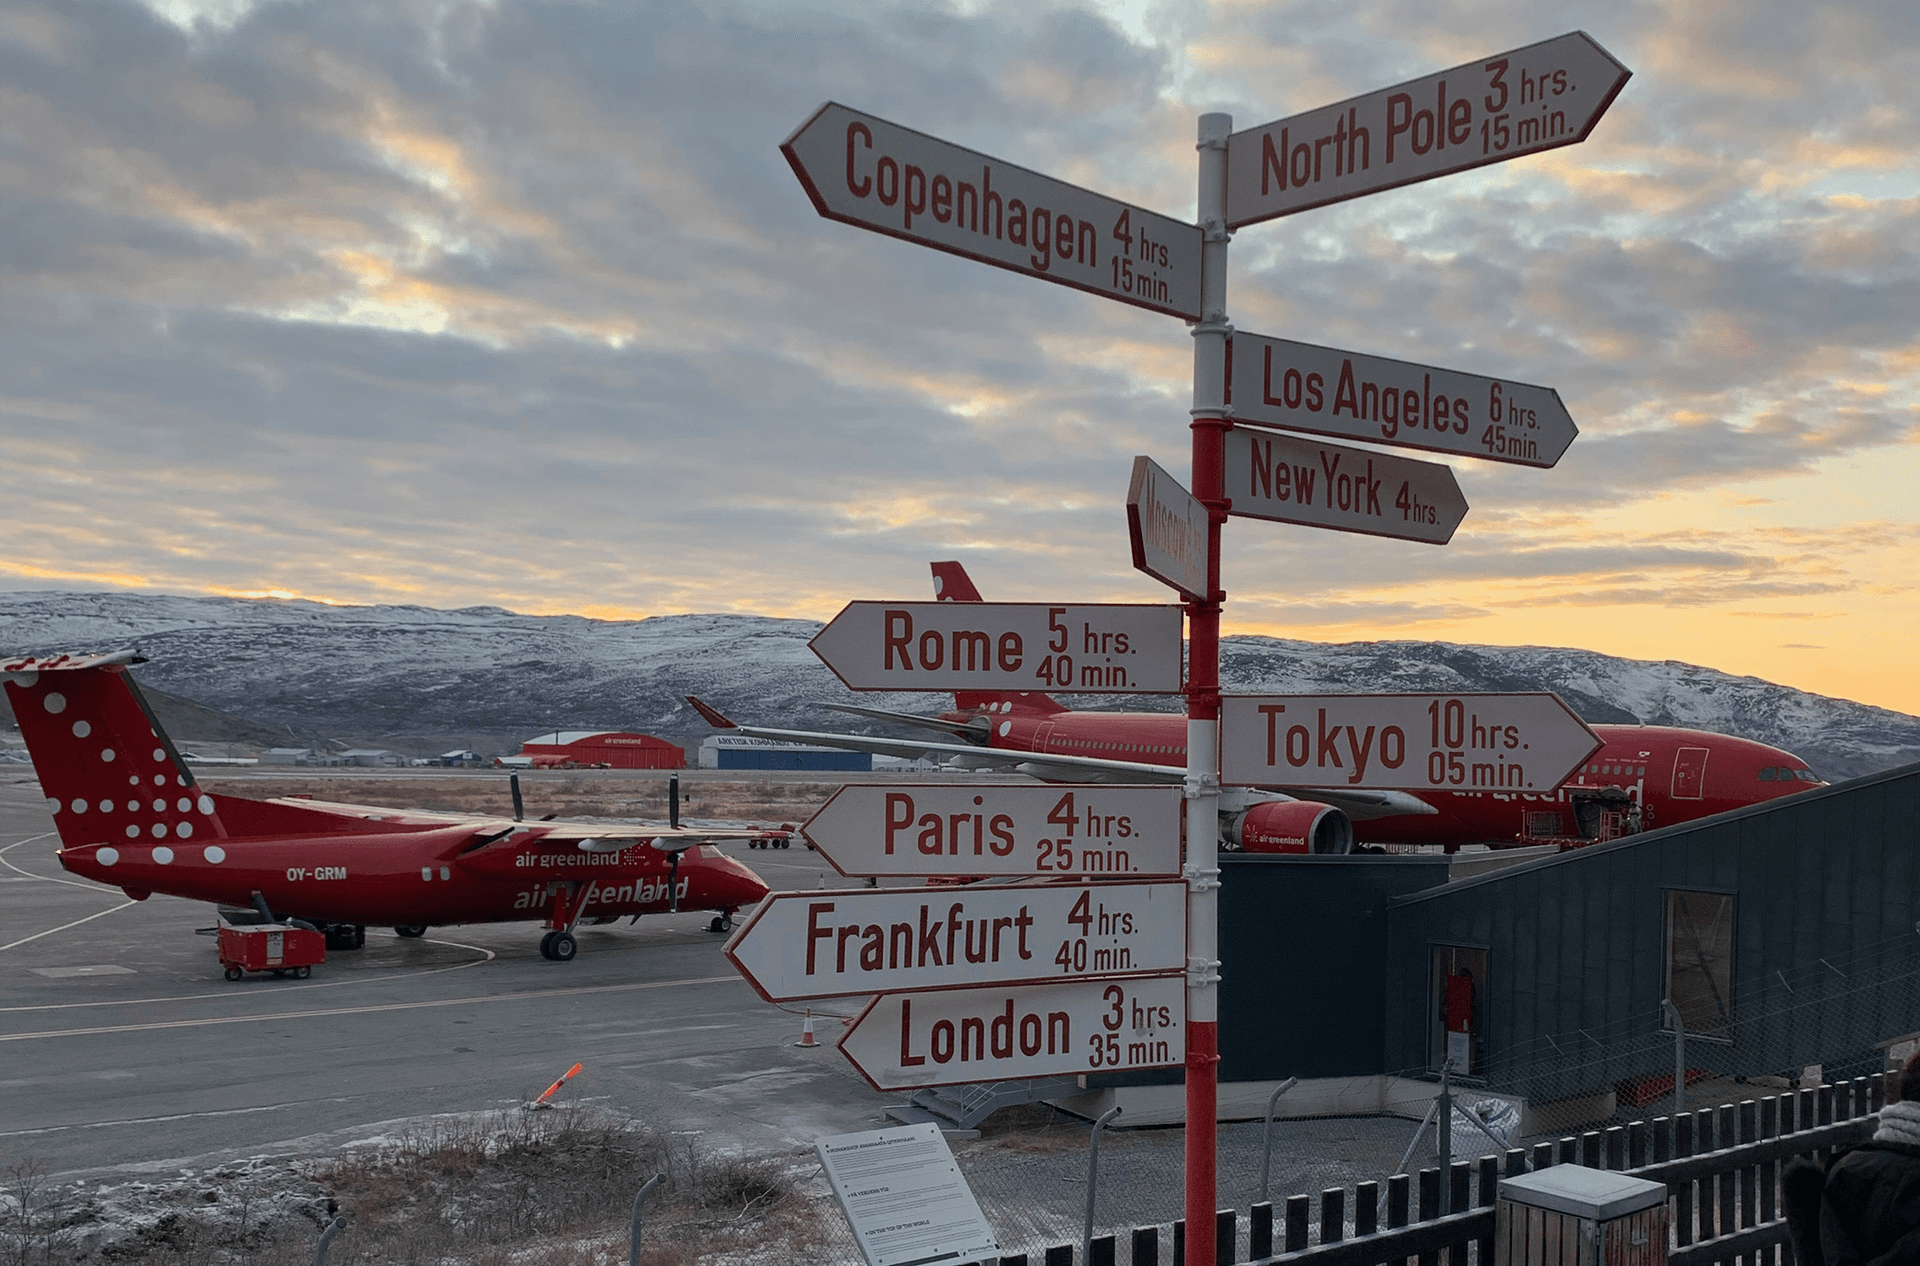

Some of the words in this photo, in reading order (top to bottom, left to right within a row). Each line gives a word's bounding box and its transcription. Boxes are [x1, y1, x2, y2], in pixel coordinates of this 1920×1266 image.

[1484, 58, 1510, 113] 3
[1520, 68, 1576, 104] hrs.
[1262, 107, 1369, 196] North
[1386, 81, 1471, 164] Pole
[1481, 114, 1510, 154] 15
[1517, 104, 1574, 146] min.
[846, 121, 1097, 271] Copenhagen
[1113, 209, 1133, 255] 4
[1140, 228, 1173, 270] hrs.
[1111, 255, 1133, 293] 15
[1136, 272, 1173, 304] min.
[1263, 345, 1324, 412] Los
[1333, 358, 1469, 438] Angeles
[1489, 382, 1503, 423] 6
[1509, 398, 1541, 430] hrs.
[1481, 424, 1506, 454] 45
[1508, 431, 1541, 460] min.
[1251, 437, 1315, 506] New
[1320, 450, 1382, 517] York
[1396, 481, 1411, 521] 4
[1413, 494, 1440, 525] hrs.
[1146, 468, 1187, 563] Moscow
[884, 609, 1023, 672] Rome
[1048, 608, 1069, 653] 5
[1084, 622, 1137, 654] hrs.
[1036, 655, 1073, 687] 40
[1081, 657, 1137, 688] min.
[1257, 704, 1406, 784] Tokyo
[1427, 700, 1464, 750] 10
[1471, 714, 1529, 751] hrs.
[1428, 755, 1465, 786] 05
[1472, 756, 1533, 788] min.
[884, 792, 1015, 857] Paris
[1046, 792, 1079, 837] 4
[1087, 805, 1139, 838] hrs.
[515, 851, 537, 867] air
[540, 850, 620, 868] greenland
[1036, 838, 1073, 871] 25
[1082, 841, 1138, 872] min.
[1259, 834, 1268, 843] air
[1269, 836, 1305, 846] greenland
[286, 867, 347, 882] OY-GRM
[514, 884, 550, 909] air
[1067, 890, 1092, 937] 4
[1099, 903, 1138, 936] hrs.
[805, 902, 1034, 976] Frankfurt
[1055, 938, 1086, 973] 40
[1094, 939, 1138, 971] min.
[1102, 985, 1124, 1032] 3
[1132, 997, 1177, 1030] hrs.
[900, 999, 1070, 1068] London
[1089, 1033, 1120, 1069] 35
[1128, 1034, 1177, 1066] min.
